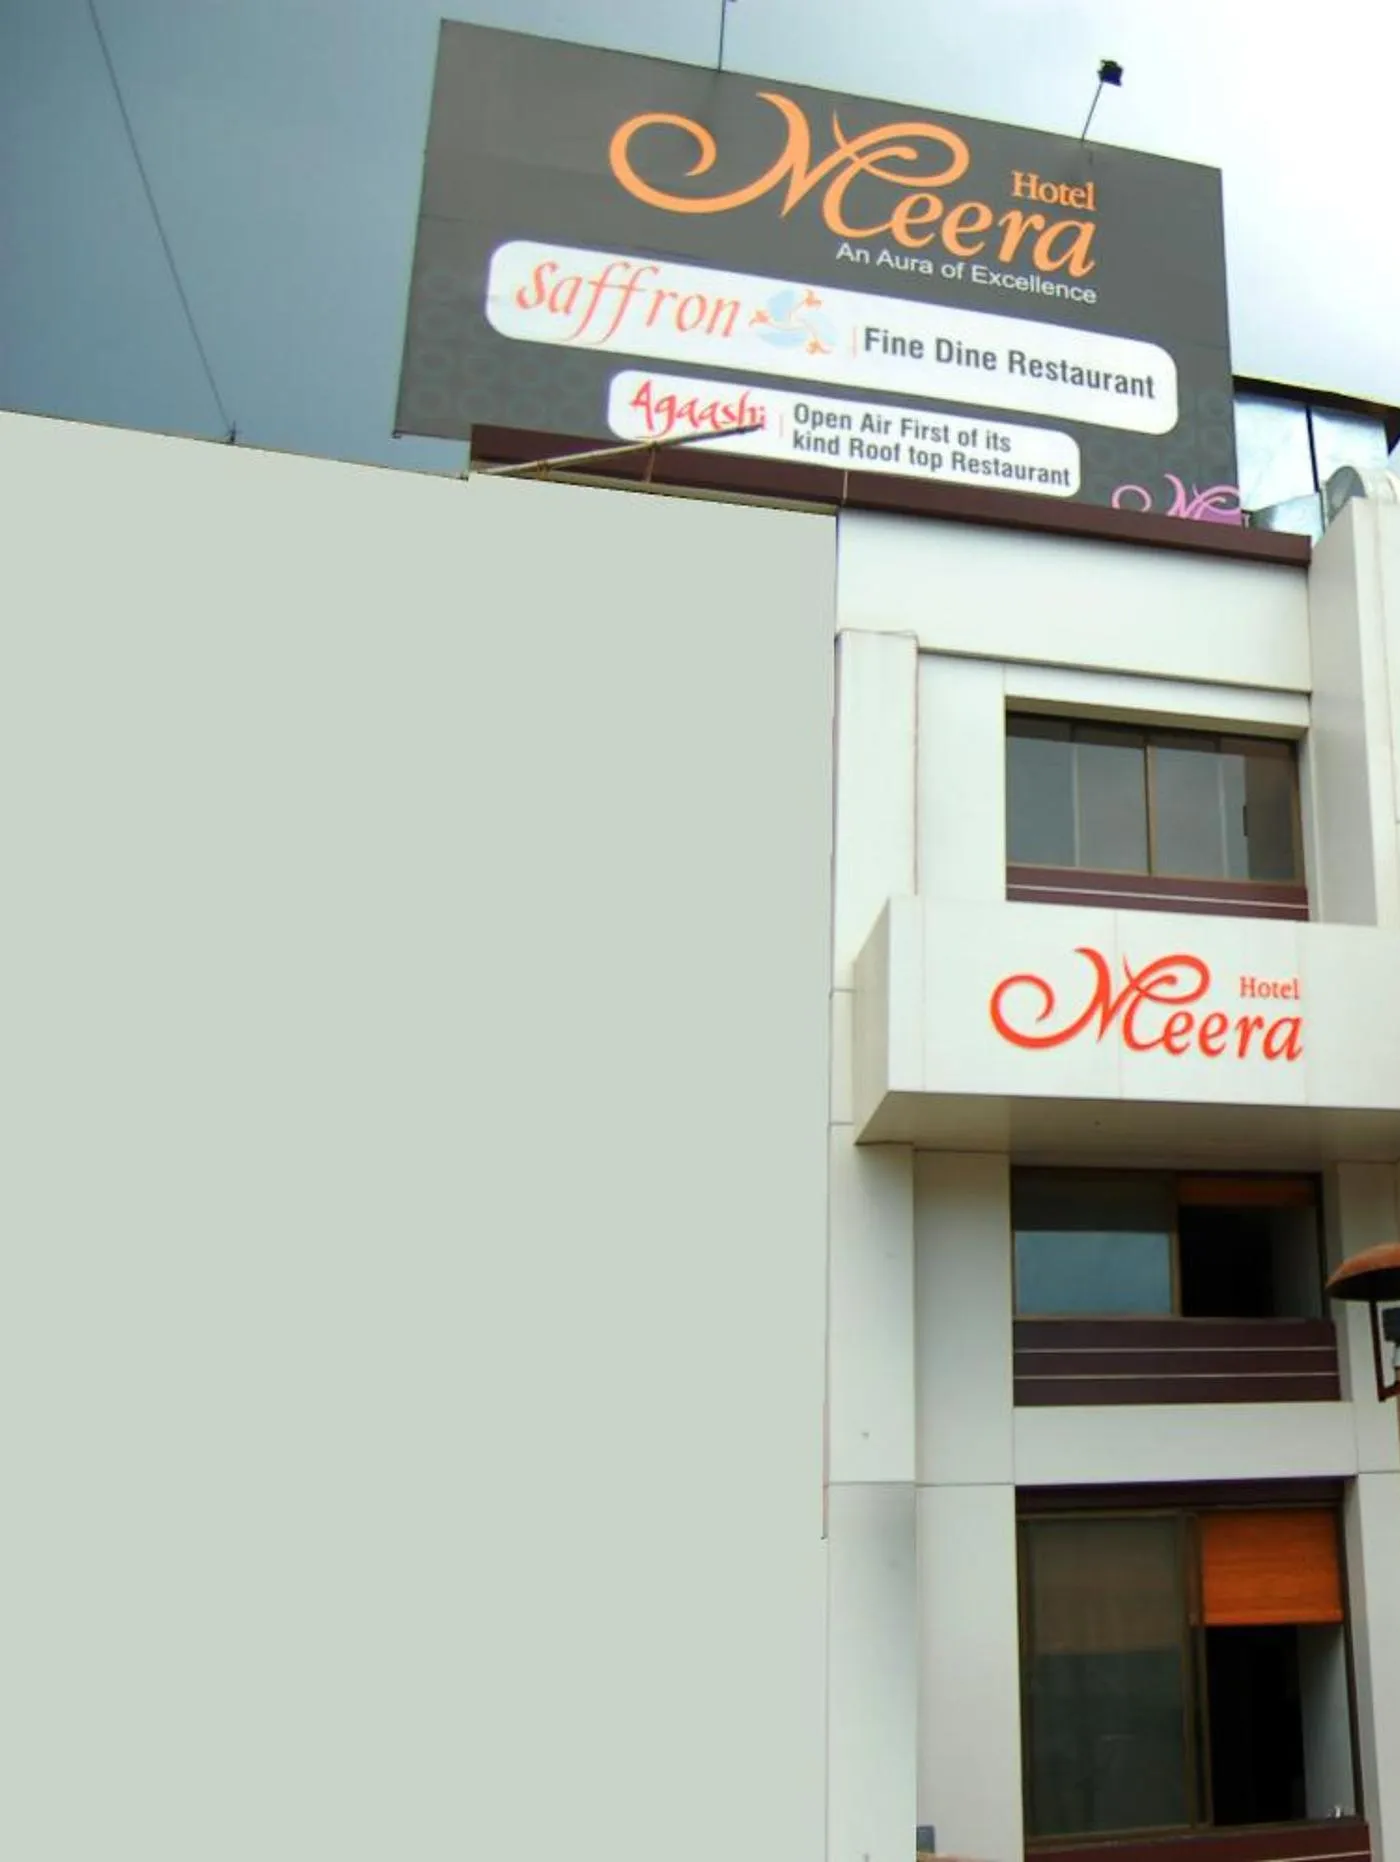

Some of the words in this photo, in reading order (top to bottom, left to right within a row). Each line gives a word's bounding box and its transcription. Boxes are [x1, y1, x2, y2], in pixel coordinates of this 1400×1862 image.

[607, 91, 1098, 278] Meera
[1011, 170, 1097, 212] Hotel
[835, 241, 871, 265] An
[875, 248, 934, 276] Aura
[940, 260, 966, 281] of
[970, 264, 1098, 305] Excellence
[863, 326, 925, 360] Fine
[934, 337, 998, 371] Dine
[1007, 349, 1157, 400] Restaurant
[793, 402, 853, 431] Open
[859, 412, 893, 435] Air
[900, 417, 950, 444] First
[957, 427, 980, 447] of
[985, 429, 1012, 453] its
[792, 430, 840, 456] kind
[849, 437, 901, 464] Roof
[908, 446, 944, 473] top
[951, 450, 1071, 488] Restaurant
[988, 946, 1304, 1062] Meera
[1238, 975, 1300, 1000] Hotel
